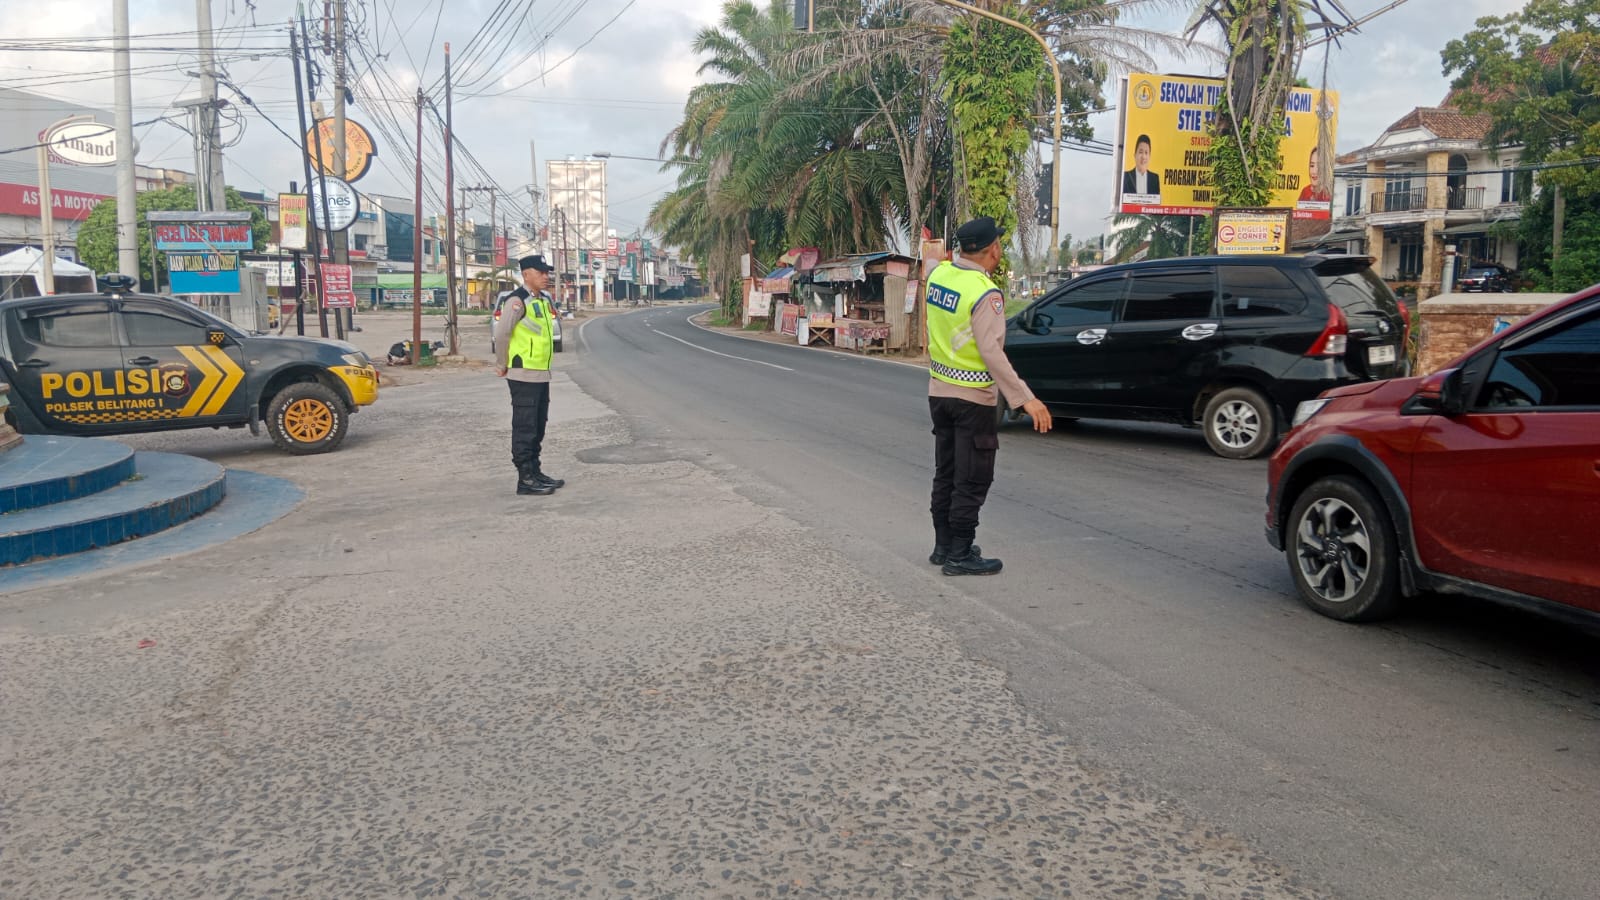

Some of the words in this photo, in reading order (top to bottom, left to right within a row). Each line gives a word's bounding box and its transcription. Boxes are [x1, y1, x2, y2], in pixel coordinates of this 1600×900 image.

[1160, 82, 1205, 105] SEKOLAH
[1286, 91, 1312, 112] NOMI
[1177, 108, 1202, 131] STIE
[1164, 168, 1197, 186] PROGRAM
[1237, 232, 1267, 240] CORNER
[927, 286, 958, 310] POLISI
[40, 368, 160, 399] POLISI
[45, 401, 94, 412] POLSEK
[97, 399, 156, 410] BELITANG
